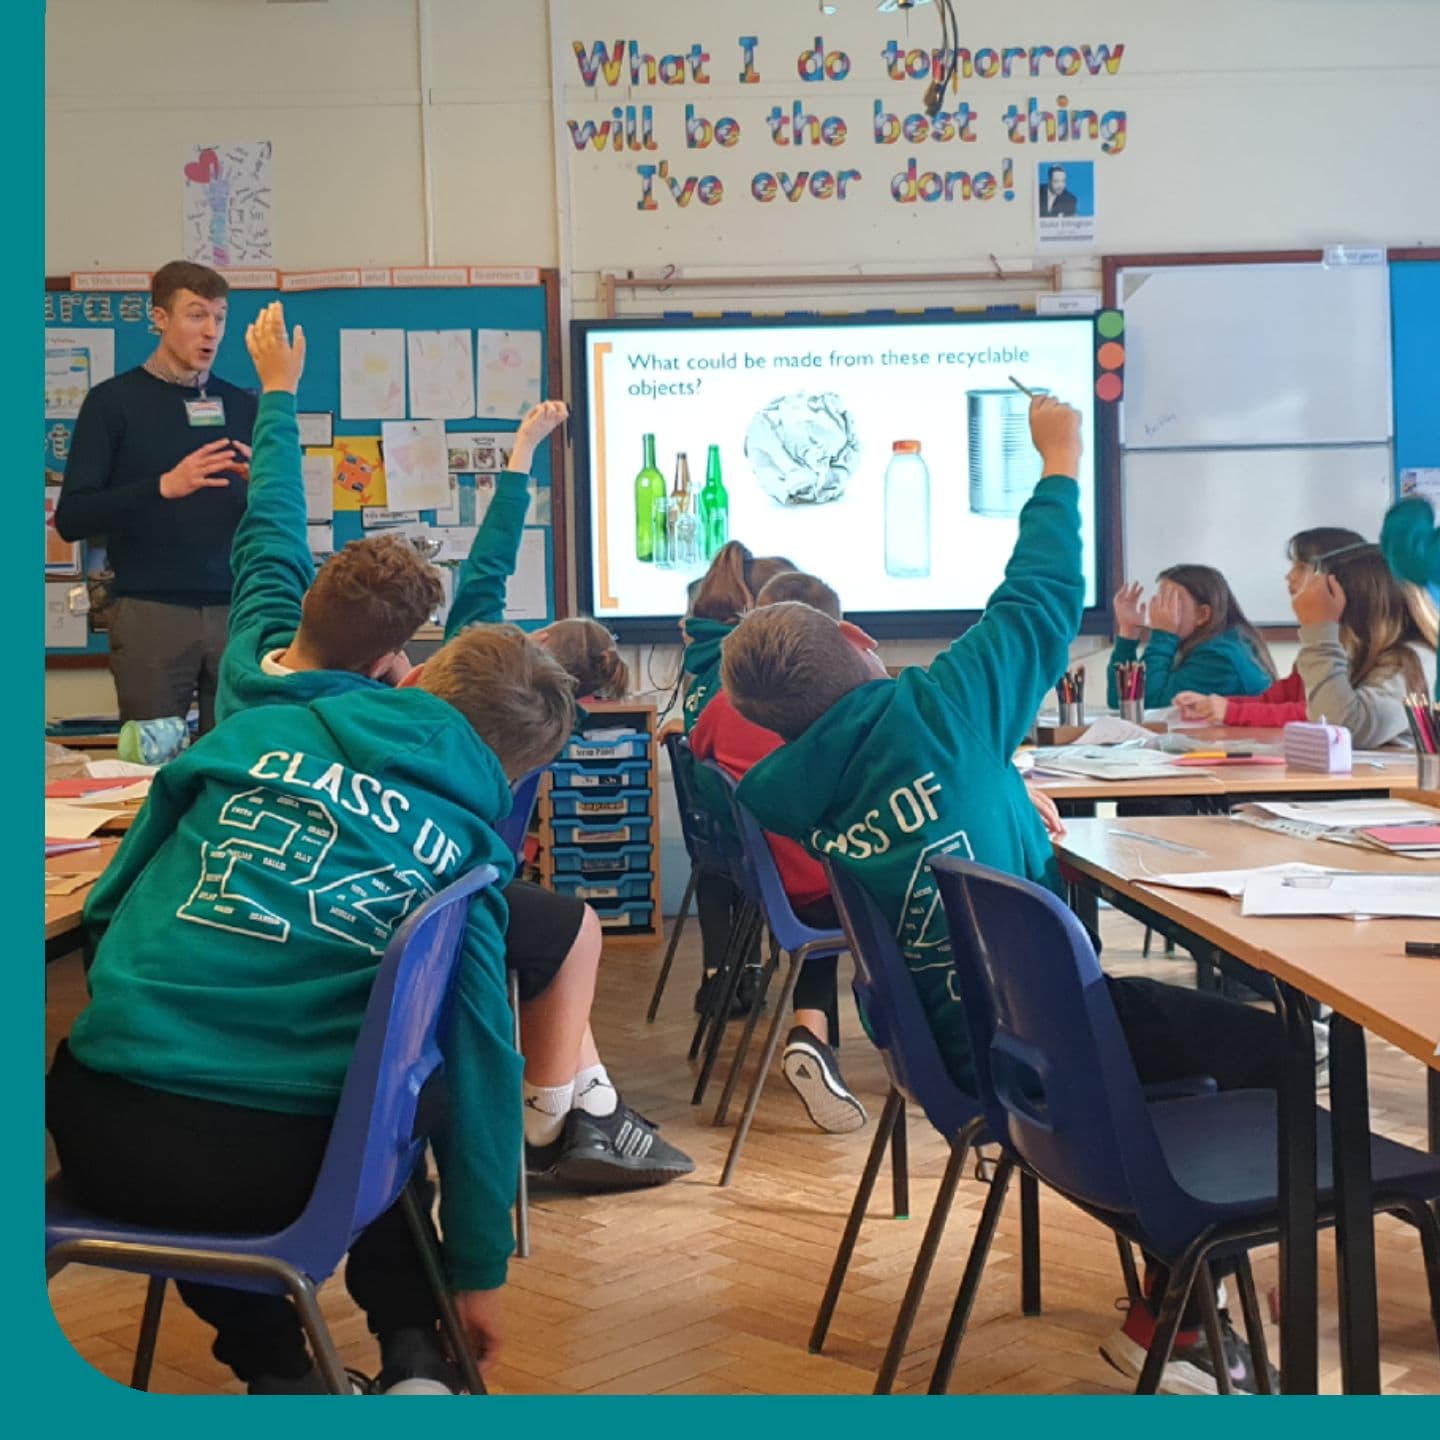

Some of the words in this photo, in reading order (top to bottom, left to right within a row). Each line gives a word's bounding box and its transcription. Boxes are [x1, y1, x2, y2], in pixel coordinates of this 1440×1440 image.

[573, 39, 710, 87] What
[738, 36, 760, 84] I
[797, 37, 850, 83] do
[881, 40, 1125, 82] tomorrow
[567, 105, 657, 151] will
[686, 103, 740, 149] be
[766, 100, 847, 148] the
[873, 99, 977, 145] best
[1001, 94, 1127, 155] thing
[636, 159, 724, 211] I've
[751, 169, 862, 202] ever
[891, 157, 1014, 203] done!
[627, 354, 679, 372] What
[686, 352, 737, 370] could
[744, 352, 767, 370] be
[773, 352, 822, 369] made
[829, 350, 874, 368] from
[880, 350, 930, 367] these
[937, 347, 1030, 368] recyclable
[627, 378, 702, 400] objects?
[249, 751, 410, 833] CLASS
[889, 771, 942, 833] OF
